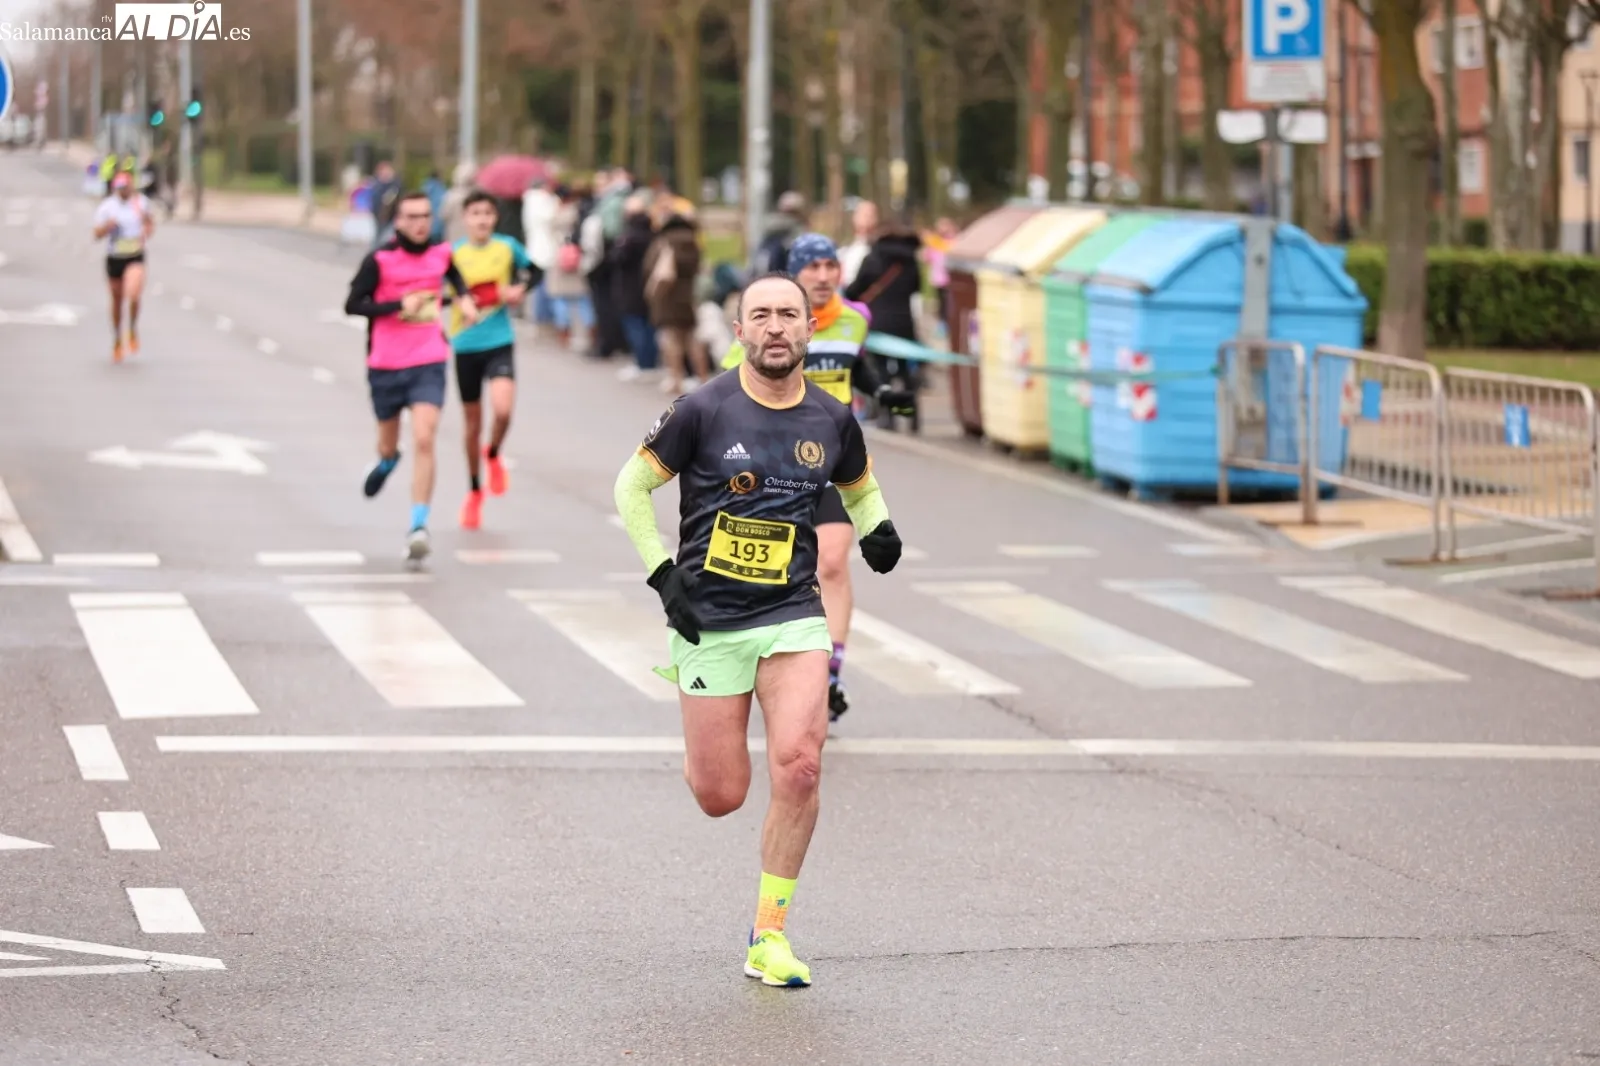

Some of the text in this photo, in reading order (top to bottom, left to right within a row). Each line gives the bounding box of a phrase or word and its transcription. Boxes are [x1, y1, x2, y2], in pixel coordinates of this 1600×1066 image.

[1261, 0, 1311, 54] P
[764, 476, 818, 491] Oktoberfest
[735, 526, 750, 534] DON
[750, 528, 771, 536] BOSCO
[729, 540, 770, 563] 193
